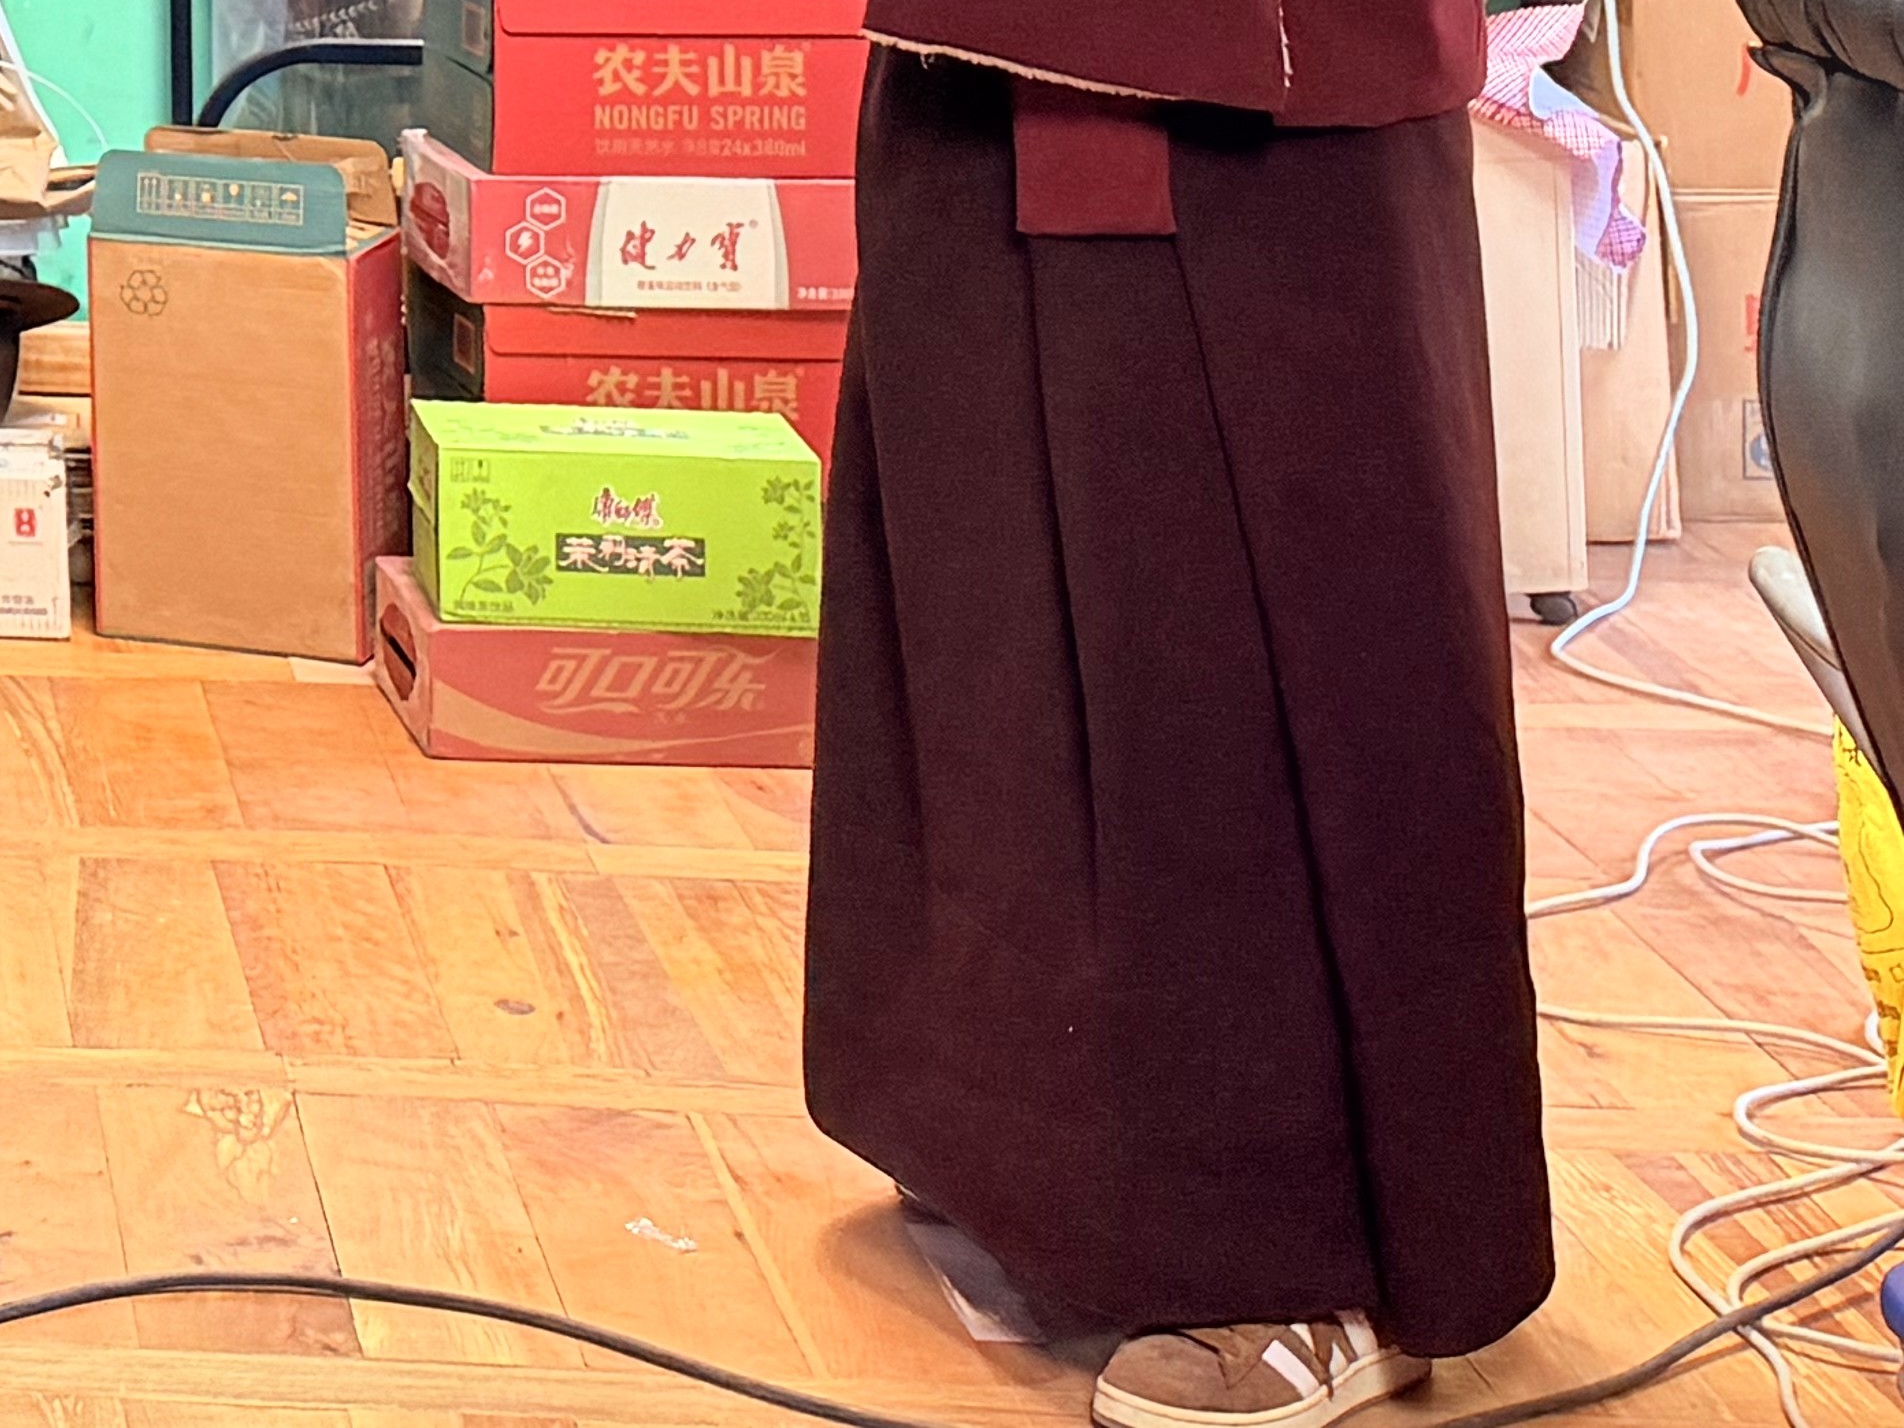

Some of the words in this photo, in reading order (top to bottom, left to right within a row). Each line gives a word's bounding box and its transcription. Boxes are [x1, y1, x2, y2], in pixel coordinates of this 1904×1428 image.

[593, 43, 807, 97] 农夫山泉
[594, 104, 699, 130] NONGFU
[709, 105, 806, 130] SPRING
[558, 535, 704, 582] 茉莉清茶
[535, 646, 784, 715] 可口可乐
